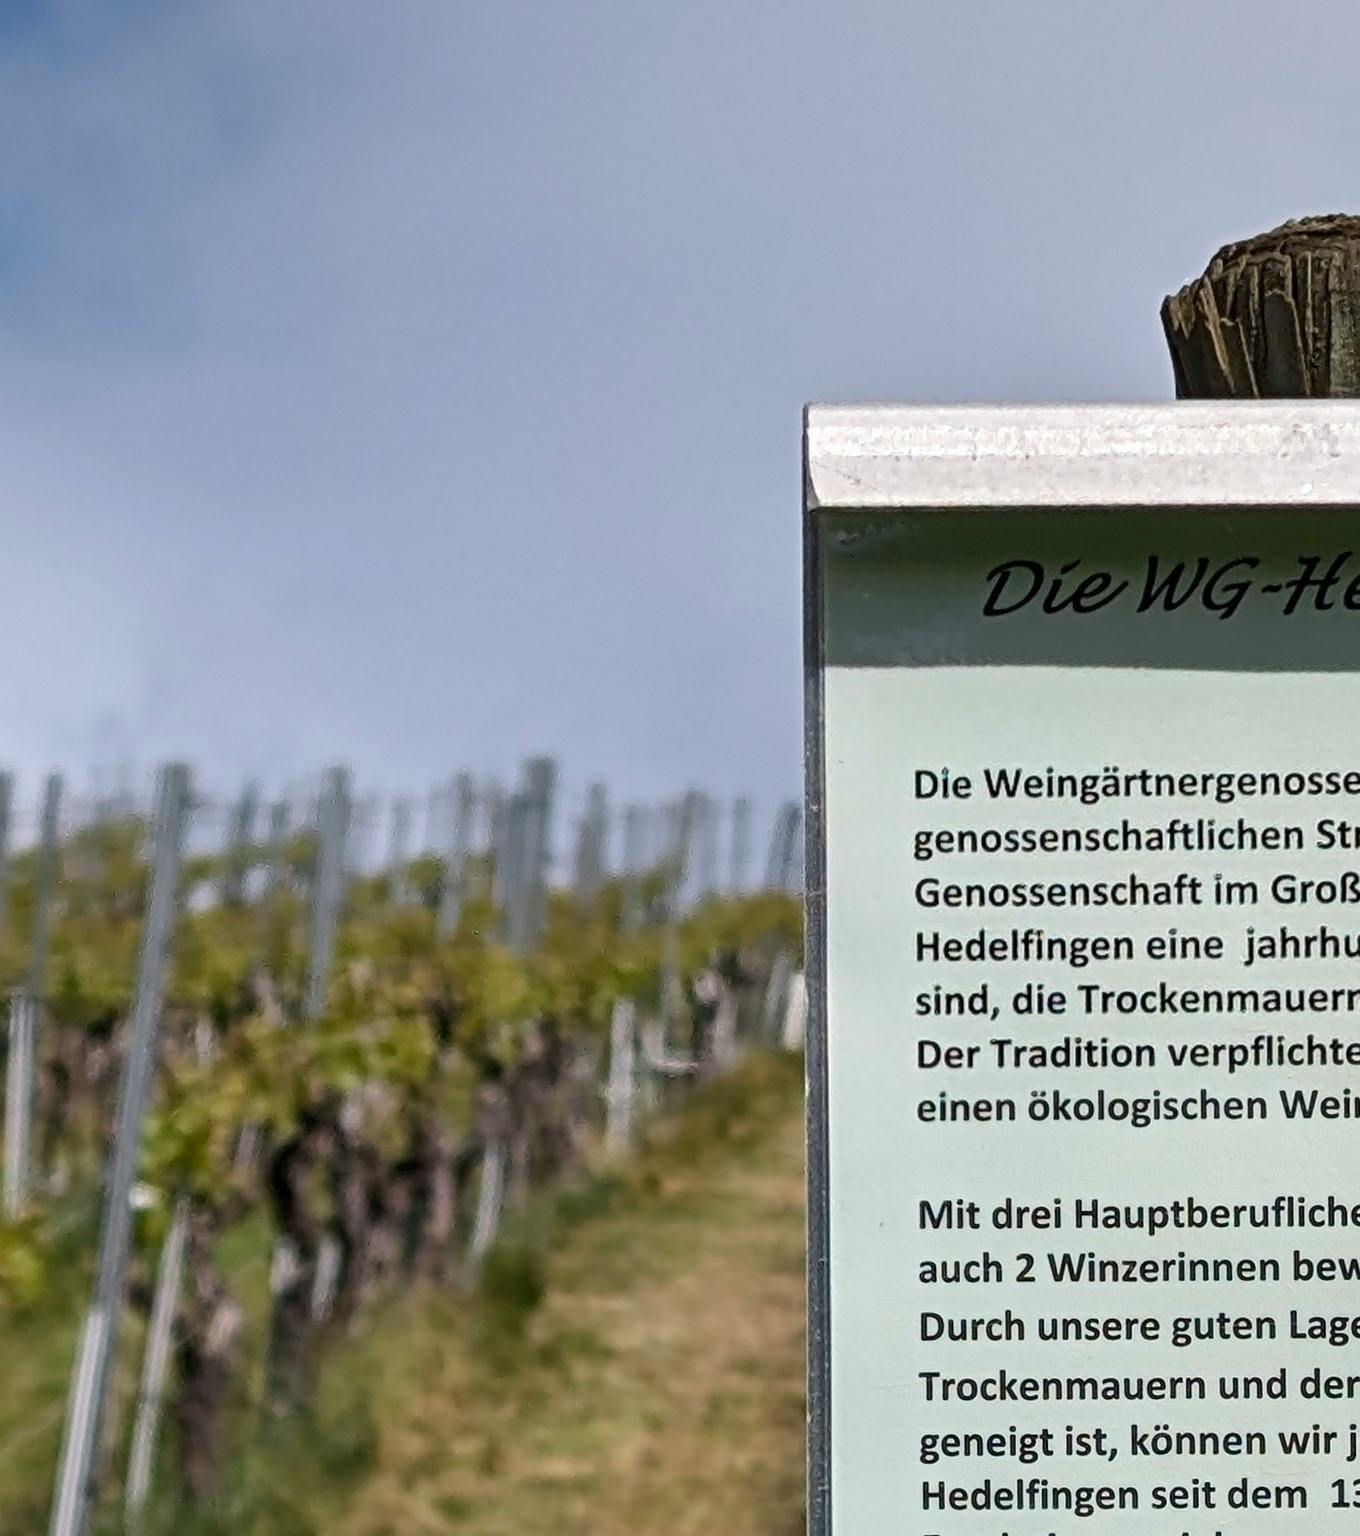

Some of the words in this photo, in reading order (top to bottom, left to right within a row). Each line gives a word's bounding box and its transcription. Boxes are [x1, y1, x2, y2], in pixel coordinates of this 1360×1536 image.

[982, 558, 1130, 617] Die
[914, 766, 973, 800] Die
[913, 817, 1305, 857] genossenschaftlichen
[914, 872, 1204, 909] Genossenschaft
[1213, 872, 1259, 906] im
[916, 927, 1134, 966] Hedelfingen
[1146, 927, 1224, 961] eine
[915, 982, 1001, 1021] sind,
[1011, 982, 1067, 1016] die
[917, 1039, 982, 1070] Der
[989, 1036, 1156, 1069] Tradition
[916, 1090, 1016, 1123] einen
[1027, 1088, 1268, 1128] ökologischen
[918, 1198, 981, 1230] Mit
[991, 1197, 1062, 1230] drei
[918, 1251, 1003, 1284] auch
[1015, 1252, 1037, 1283] 2
[1046, 1250, 1280, 1284] Winzerinnen
[920, 1308, 1025, 1342] Durch
[1037, 1317, 1161, 1342] unsere
[1171, 1312, 1277, 1348] guten
[917, 1368, 1206, 1402] Trockenmauern
[1218, 1367, 1287, 1400] und
[919, 1425, 1055, 1465] geneigt
[1065, 1424, 1118, 1463] ist,
[1130, 1423, 1267, 1456] können
[1277, 1423, 1338, 1455] wir
[922, 1478, 1139, 1515] Hedelfingen
[1151, 1478, 1217, 1510] seit
[1227, 1476, 1308, 1510] dem
